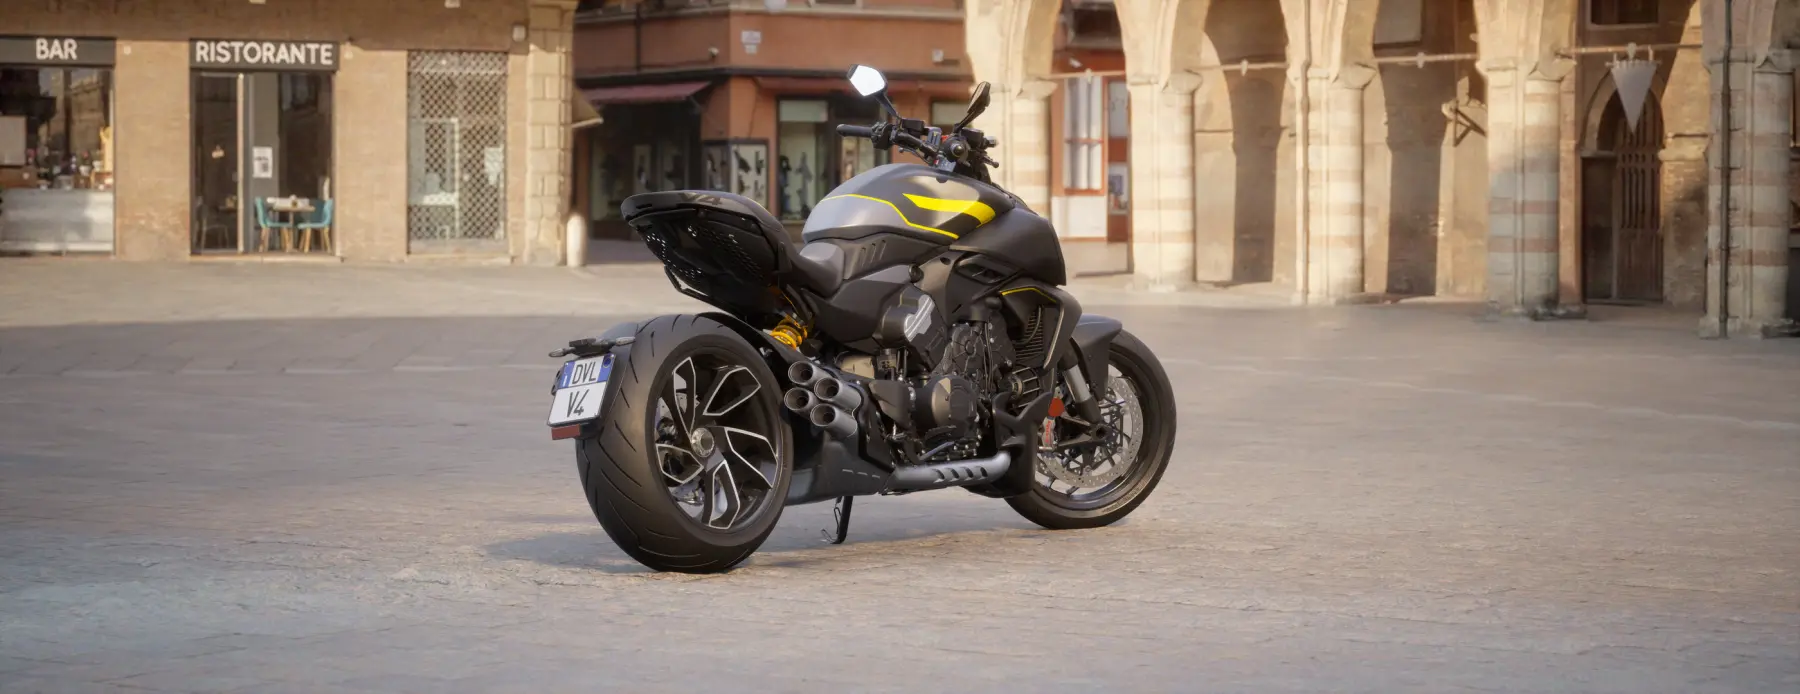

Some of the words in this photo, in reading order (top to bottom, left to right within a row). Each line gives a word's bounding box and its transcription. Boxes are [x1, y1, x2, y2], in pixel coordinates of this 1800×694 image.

[36, 38, 78, 60] BAR
[195, 40, 333, 65] RISTORANTE
[572, 361, 597, 384] DVL
[567, 389, 590, 418] V4
